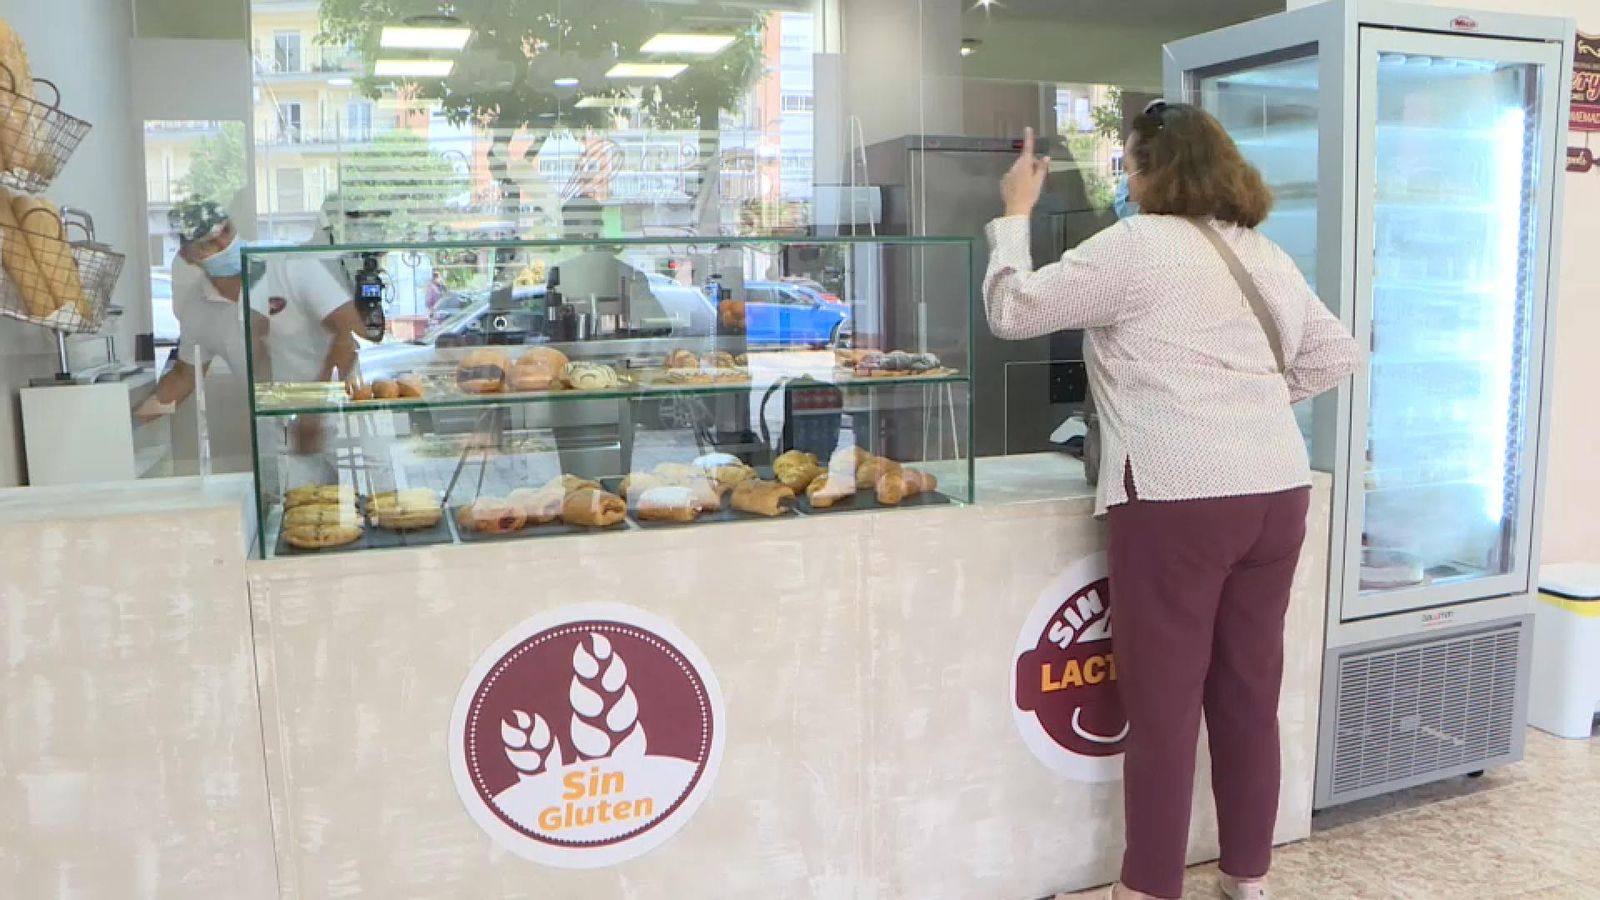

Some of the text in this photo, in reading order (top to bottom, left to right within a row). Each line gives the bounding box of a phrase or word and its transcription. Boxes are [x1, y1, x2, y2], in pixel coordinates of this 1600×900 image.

[1047, 588, 1104, 650] SIN
[562, 767, 624, 800] Sin
[538, 797, 653, 831] Gluten
